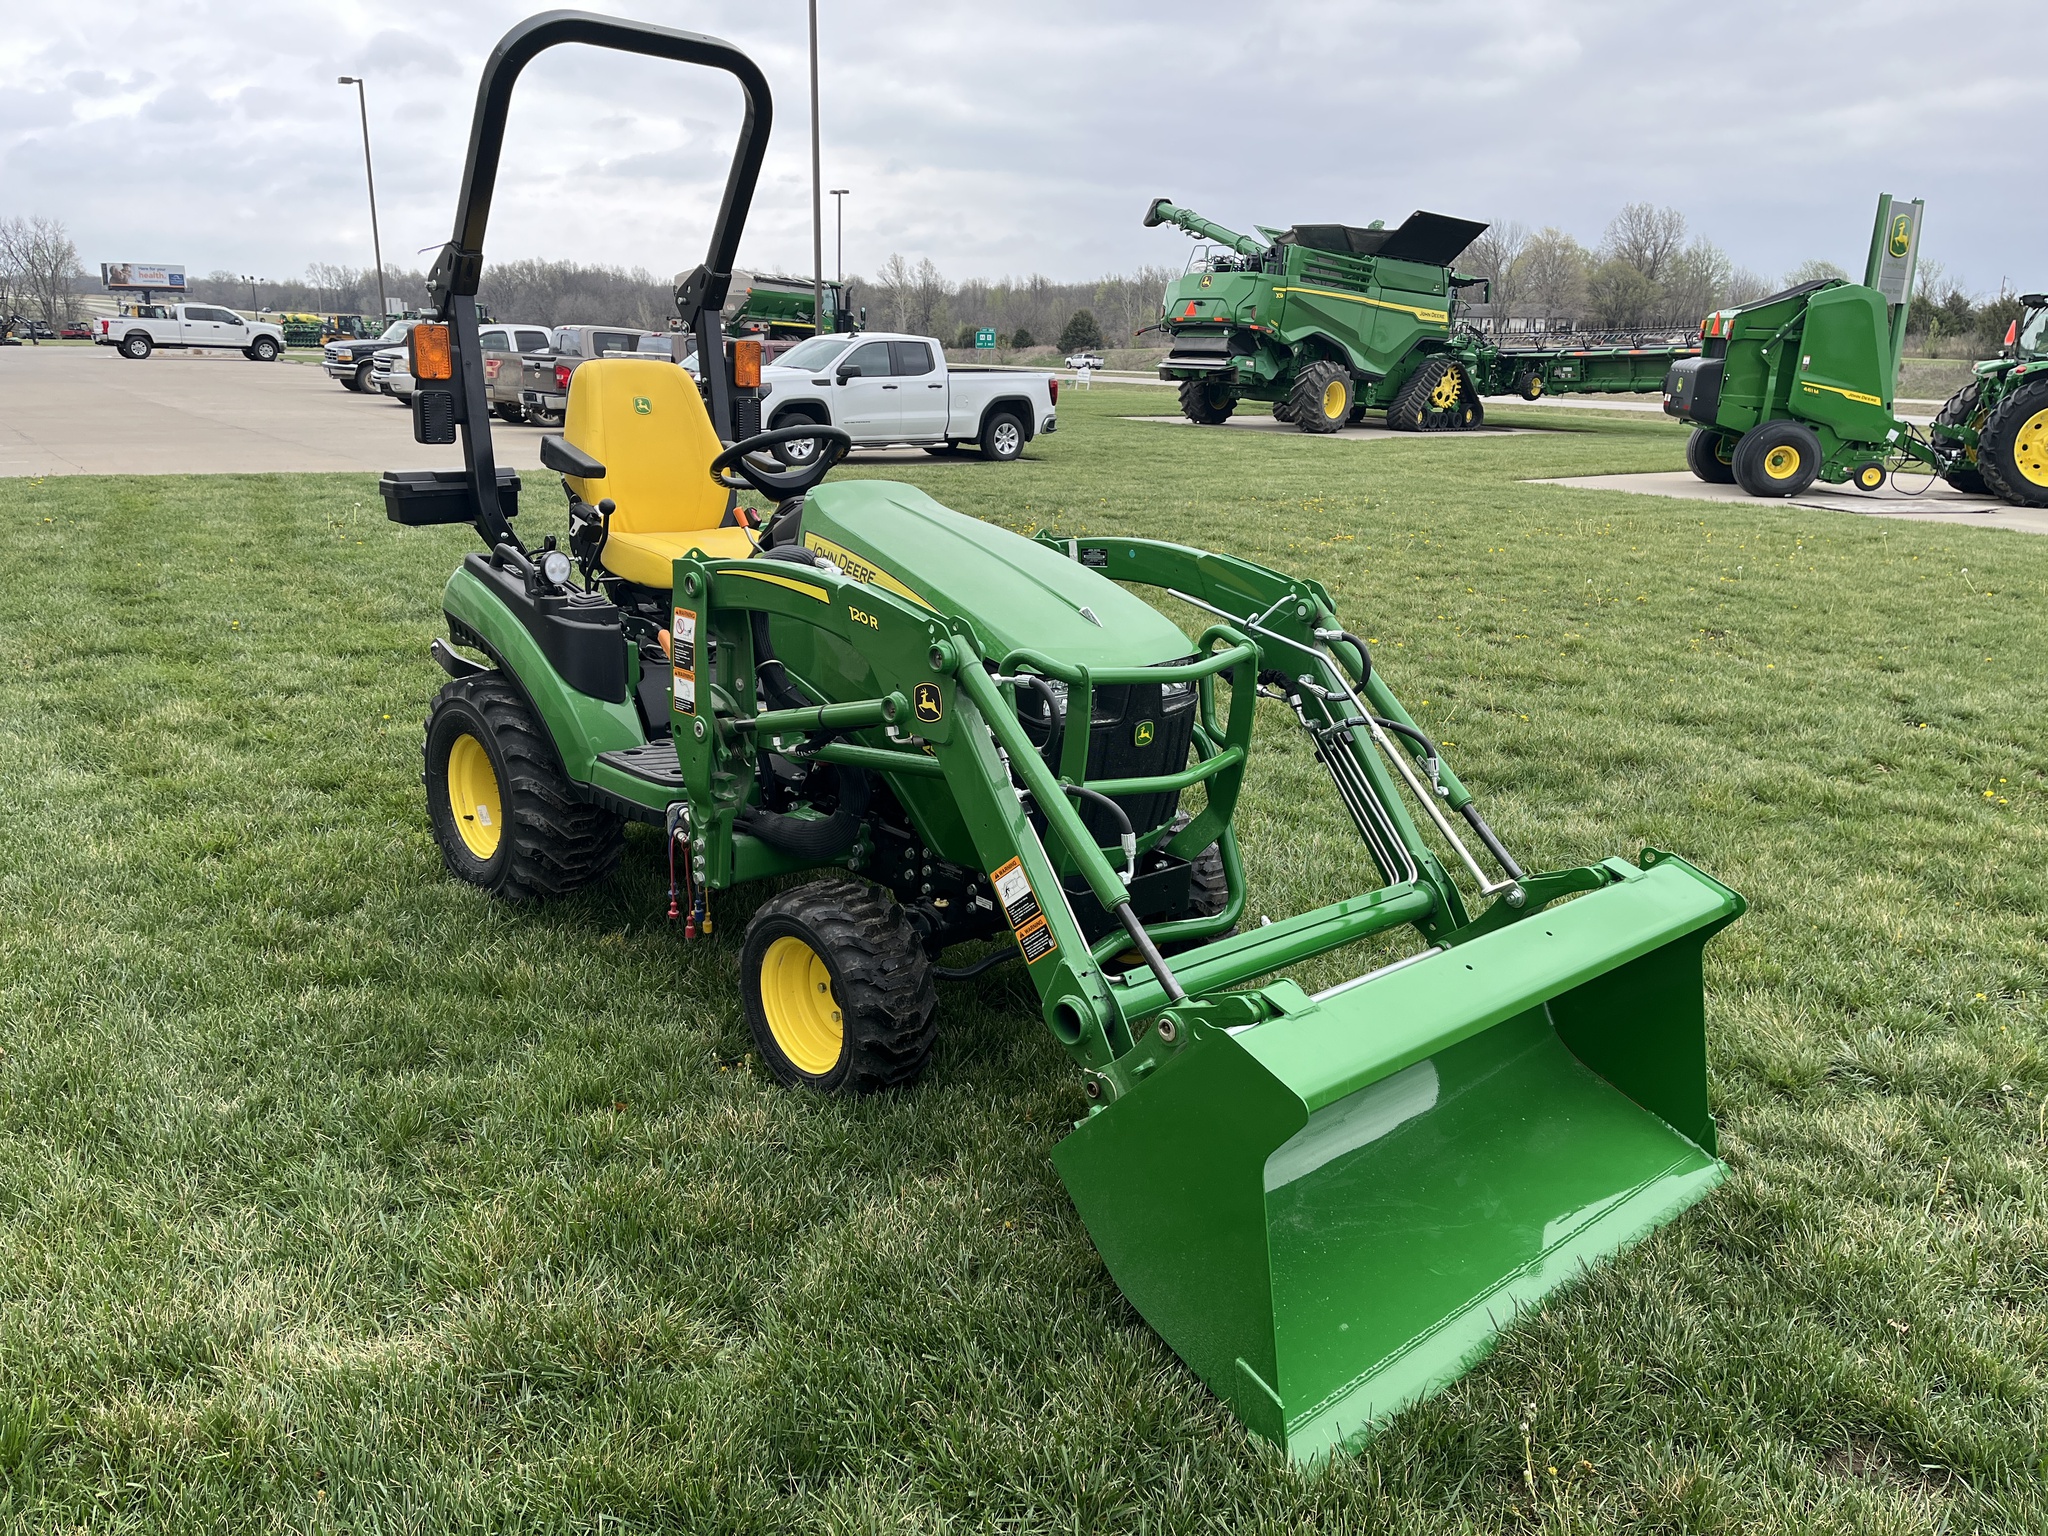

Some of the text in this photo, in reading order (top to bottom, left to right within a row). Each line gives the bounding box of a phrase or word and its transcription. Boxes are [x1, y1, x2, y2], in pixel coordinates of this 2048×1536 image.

[139, 271, 167, 279] health.
[1431, 311, 1445, 319] DEERE
[1861, 395, 1878, 403] DEERE
[837, 552, 876, 584] DEERE
[999, 860, 1017, 875] WARNING
[1023, 919, 1044, 935] WARNING
